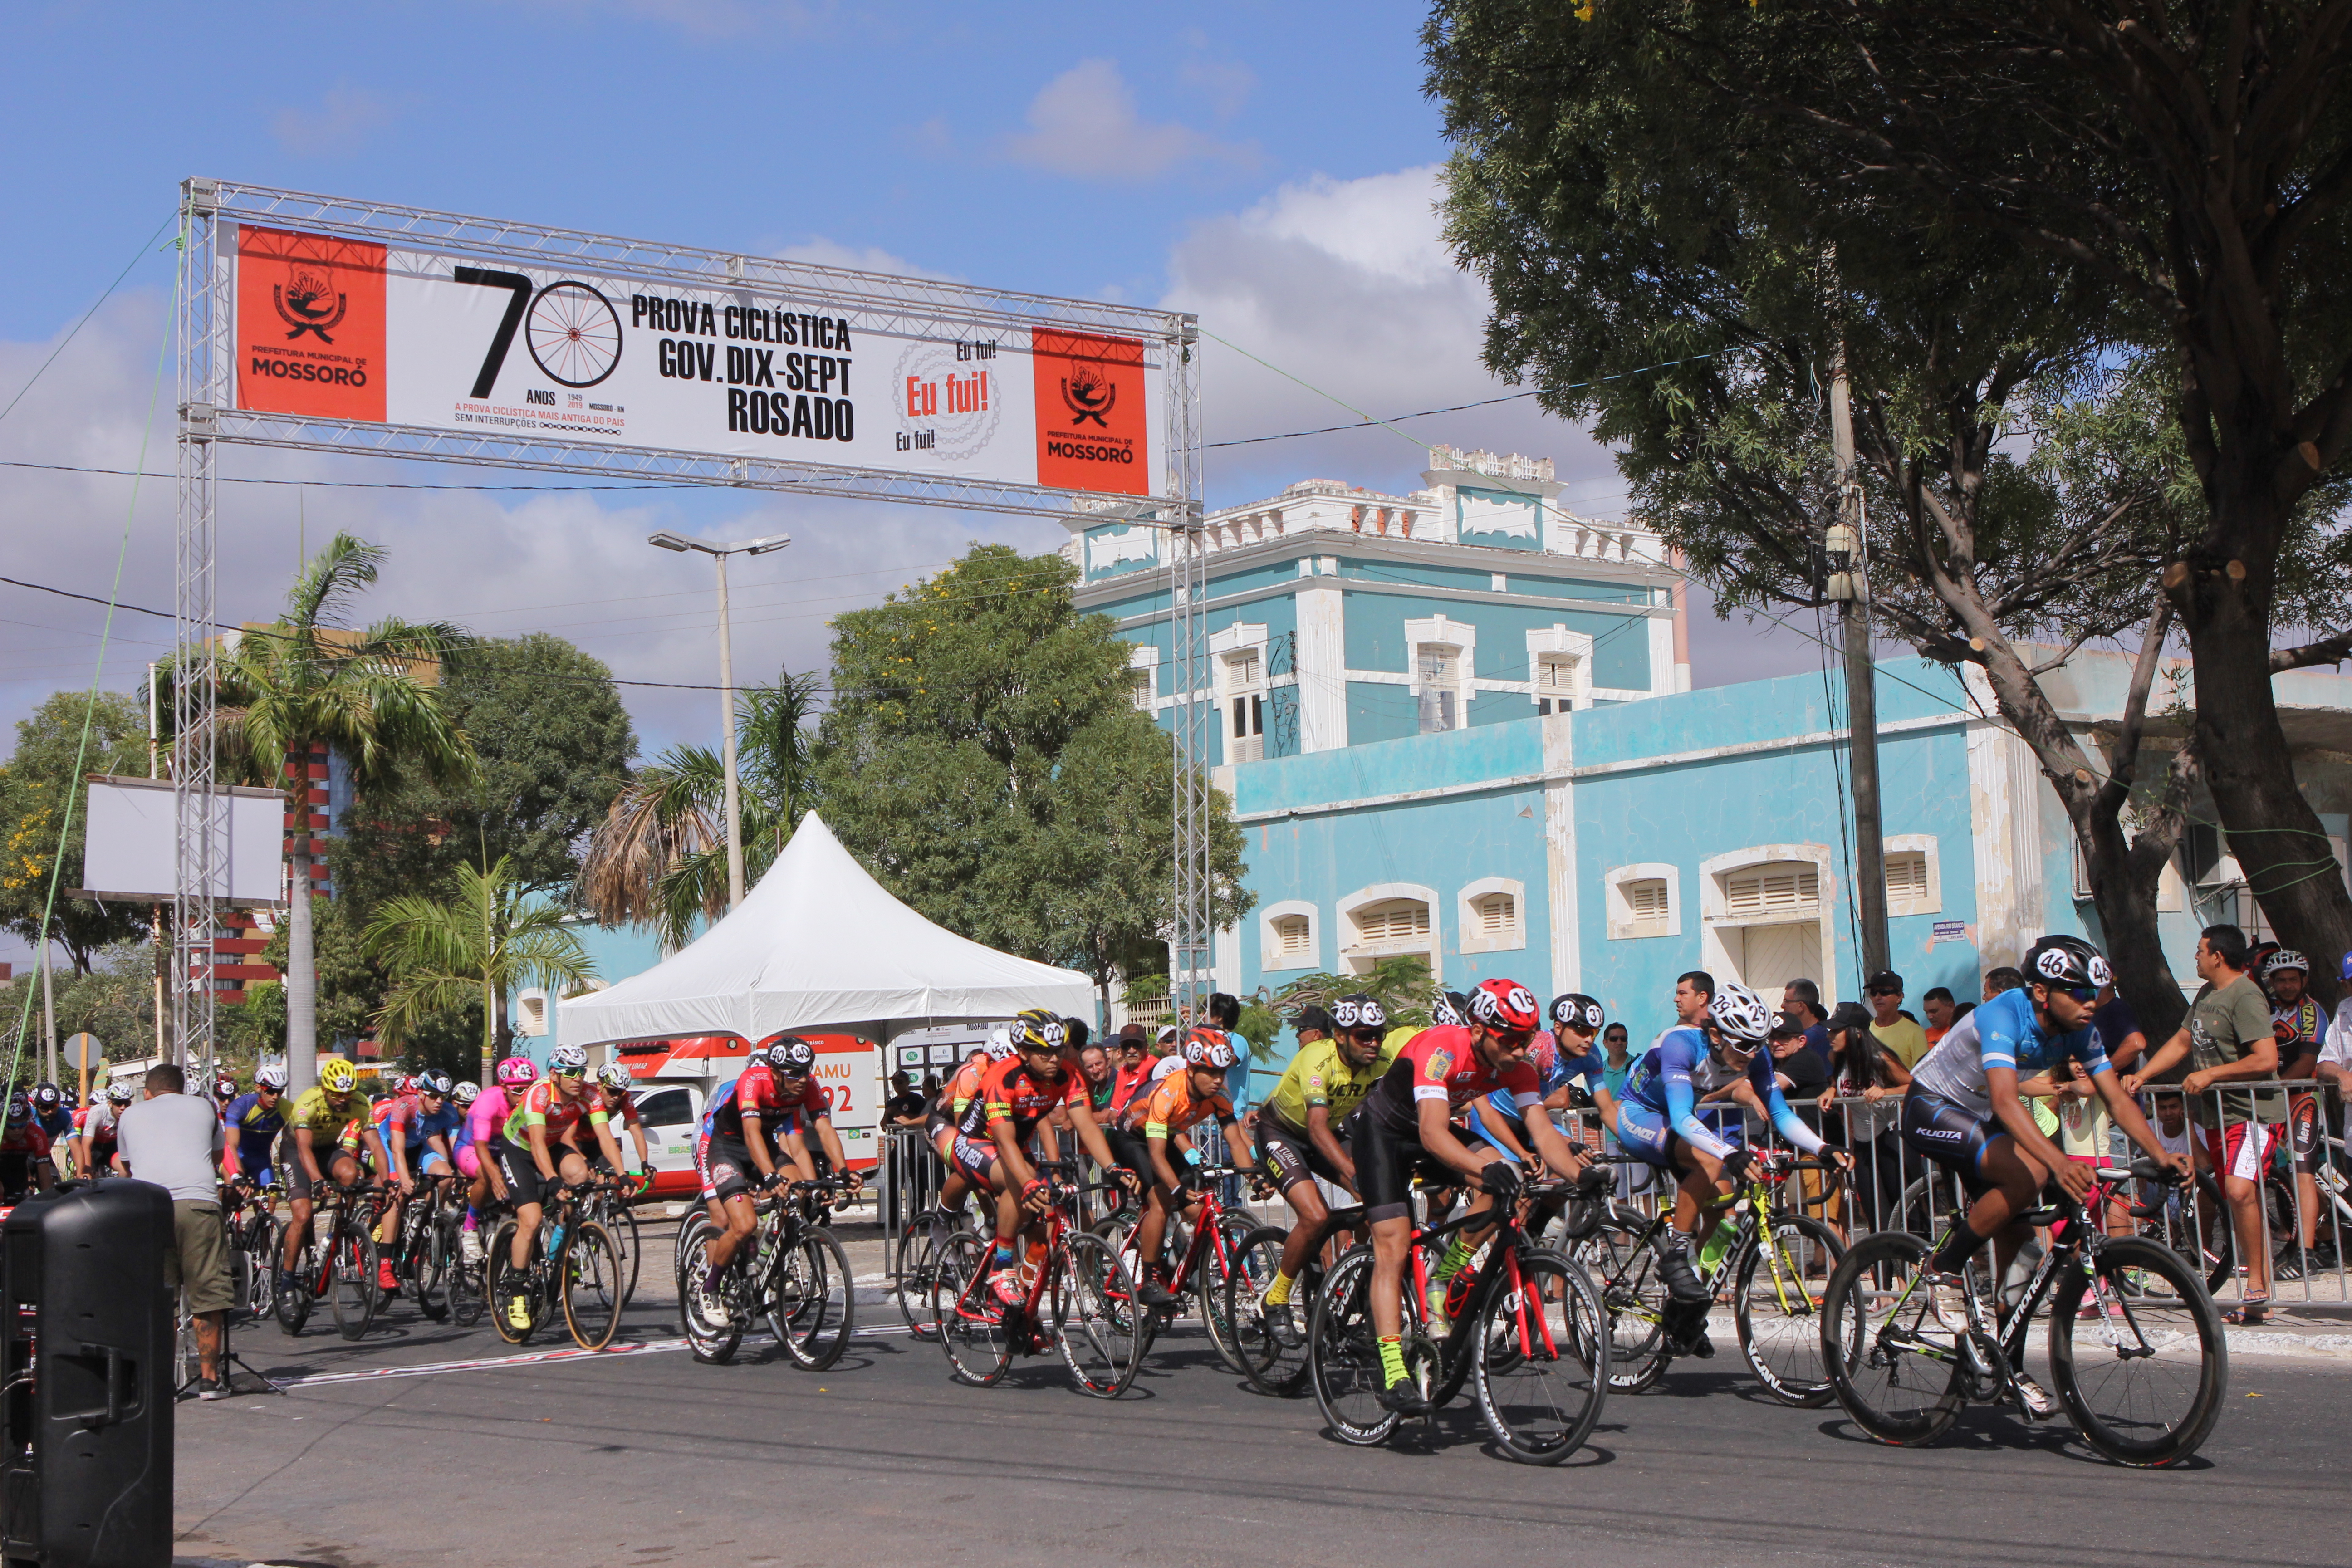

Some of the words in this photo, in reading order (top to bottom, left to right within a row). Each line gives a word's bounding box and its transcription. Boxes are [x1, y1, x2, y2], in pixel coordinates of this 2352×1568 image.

[632, 294, 717, 337] PROVA
[725, 305, 852, 351] CICLÍSTICA
[252, 345, 305, 358] PREFEITURA
[307, 352, 353, 364] MUNICIPAL
[956, 341, 971, 361] Eu
[975, 339, 996, 360] fui!
[252, 358, 367, 387] MOSSORÓ
[659, 338, 723, 383] GOV.
[727, 345, 852, 396] DIX-SEPT
[526, 389, 556, 406] ANOS
[907, 376, 937, 417] Eu
[946, 371, 988, 413] fui!
[455, 402, 461, 411] A
[464, 403, 491, 414] PROVA
[493, 406, 536, 418] CICLÍSTICA
[538, 410, 559, 421] MAIS
[561, 413, 591, 424] ANTIGA
[593, 416, 604, 425] DO
[607, 416, 625, 427] PAÍS
[589, 403, 613, 412] MOSSORÓ
[728, 388, 854, 442] ROSADO
[455, 413, 473, 422] SEM
[475, 414, 536, 429] INTERRUPÇÕES
[896, 432, 910, 451] Eu
[914, 429, 935, 450] fui!
[1047, 431, 1087, 441] PREFEITURA
[1088, 435, 1122, 445] MUNICIPAL
[1048, 441, 1133, 464] MOSSORÓ
[2041, 954, 2063, 974] 46
[1478, 995, 1493, 1017] 16
[1514, 991, 1534, 1008] 16
[1712, 995, 1730, 1014] 29
[1339, 1005, 1356, 1021] 35
[1366, 1006, 1383, 1021] 35
[1559, 1004, 1573, 1019] 31
[1589, 1008, 1602, 1023] 31
[1749, 1005, 1766, 1022] 29
[1012, 1022, 1025, 1039] 22
[1047, 1025, 1063, 1042] 22
[571, 1048, 583, 1058] 39
[771, 1048, 784, 1062] 40
[796, 1046, 810, 1059] 40
[992, 1042, 1004, 1057] 34
[1189, 1044, 1201, 1060] 13
[1215, 1047, 1231, 1063] 13
[275, 1072, 285, 1082] 11
[520, 1066, 532, 1076] 43
[813, 1063, 851, 1079] AMU
[339, 1078, 352, 1088] 36
[439, 1080, 450, 1090] 15
[467, 1086, 478, 1094] 26
[618, 1077, 628, 1086] 50
[745, 1079, 755, 1098] SOU
[45, 1090, 54, 1098] 12
[820, 1085, 853, 1112] 92
[10, 1105, 22, 1114] 23
[2297, 1103, 2314, 1144] AeroBike
[1916, 1127, 1963, 1140] KUOTA
[668, 1146, 691, 1154] BRAS
[1710, 1142, 1723, 1152] net
[967, 1147, 984, 1169] BECO
[1279, 1146, 1299, 1167] TURIM
[1267, 1157, 1284, 1179] UCRJ
[287, 1169, 296, 1188] TURIM
[759, 1226, 786, 1289] SCOTT
[1706, 1215, 1754, 1299] FOCUS
[1324, 1254, 1367, 1298] CONCEPT
[1999, 1251, 2055, 1347] cannondale
[956, 1362, 985, 1382] FUTURA
